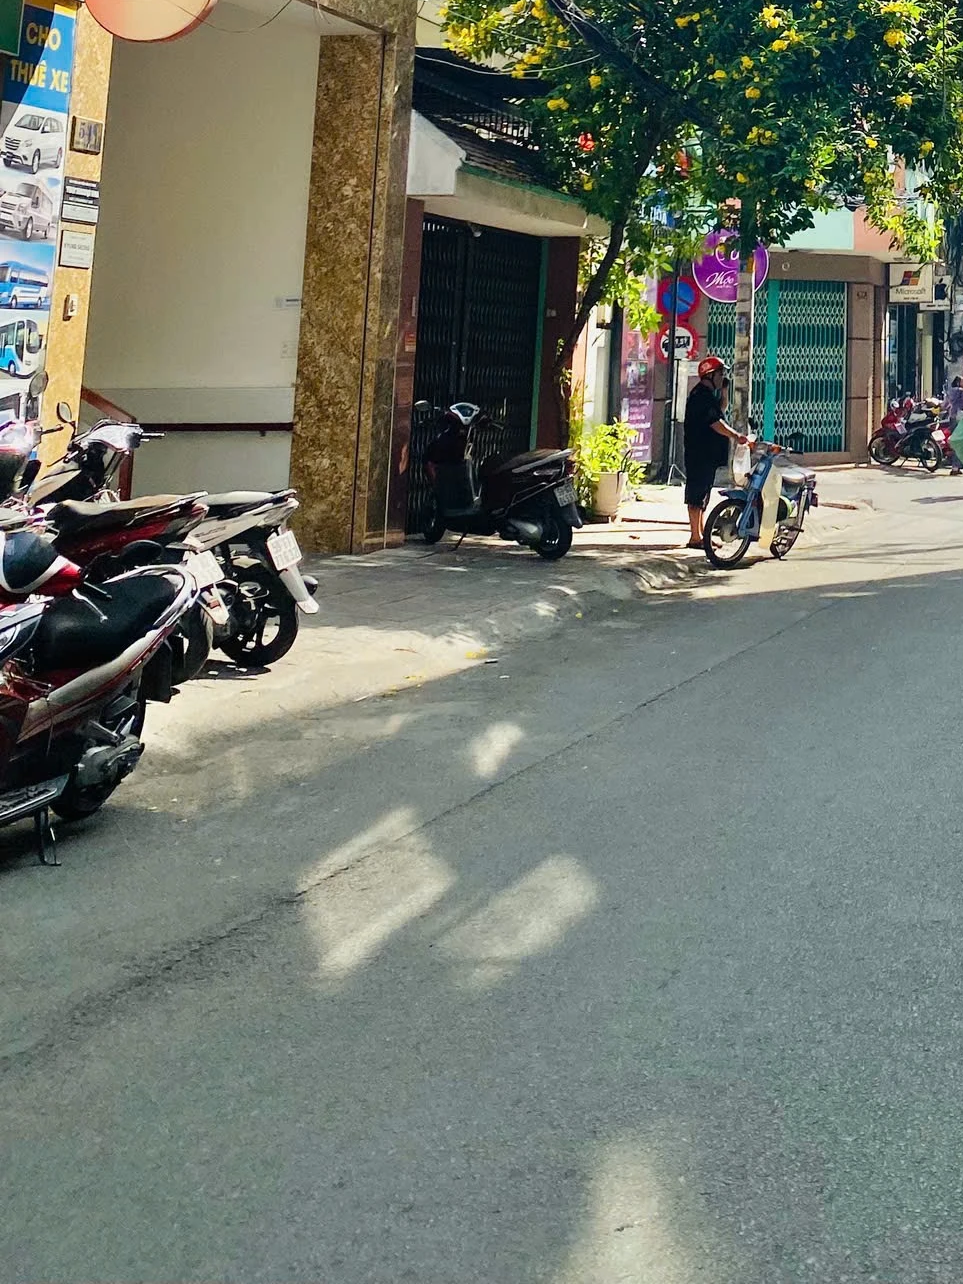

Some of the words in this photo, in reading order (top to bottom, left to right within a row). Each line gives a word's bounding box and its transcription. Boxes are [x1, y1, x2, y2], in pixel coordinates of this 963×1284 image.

[25, 22, 61, 51] CHO
[10, 59, 47, 88] THUÊ
[49, 68, 69, 93] XE
